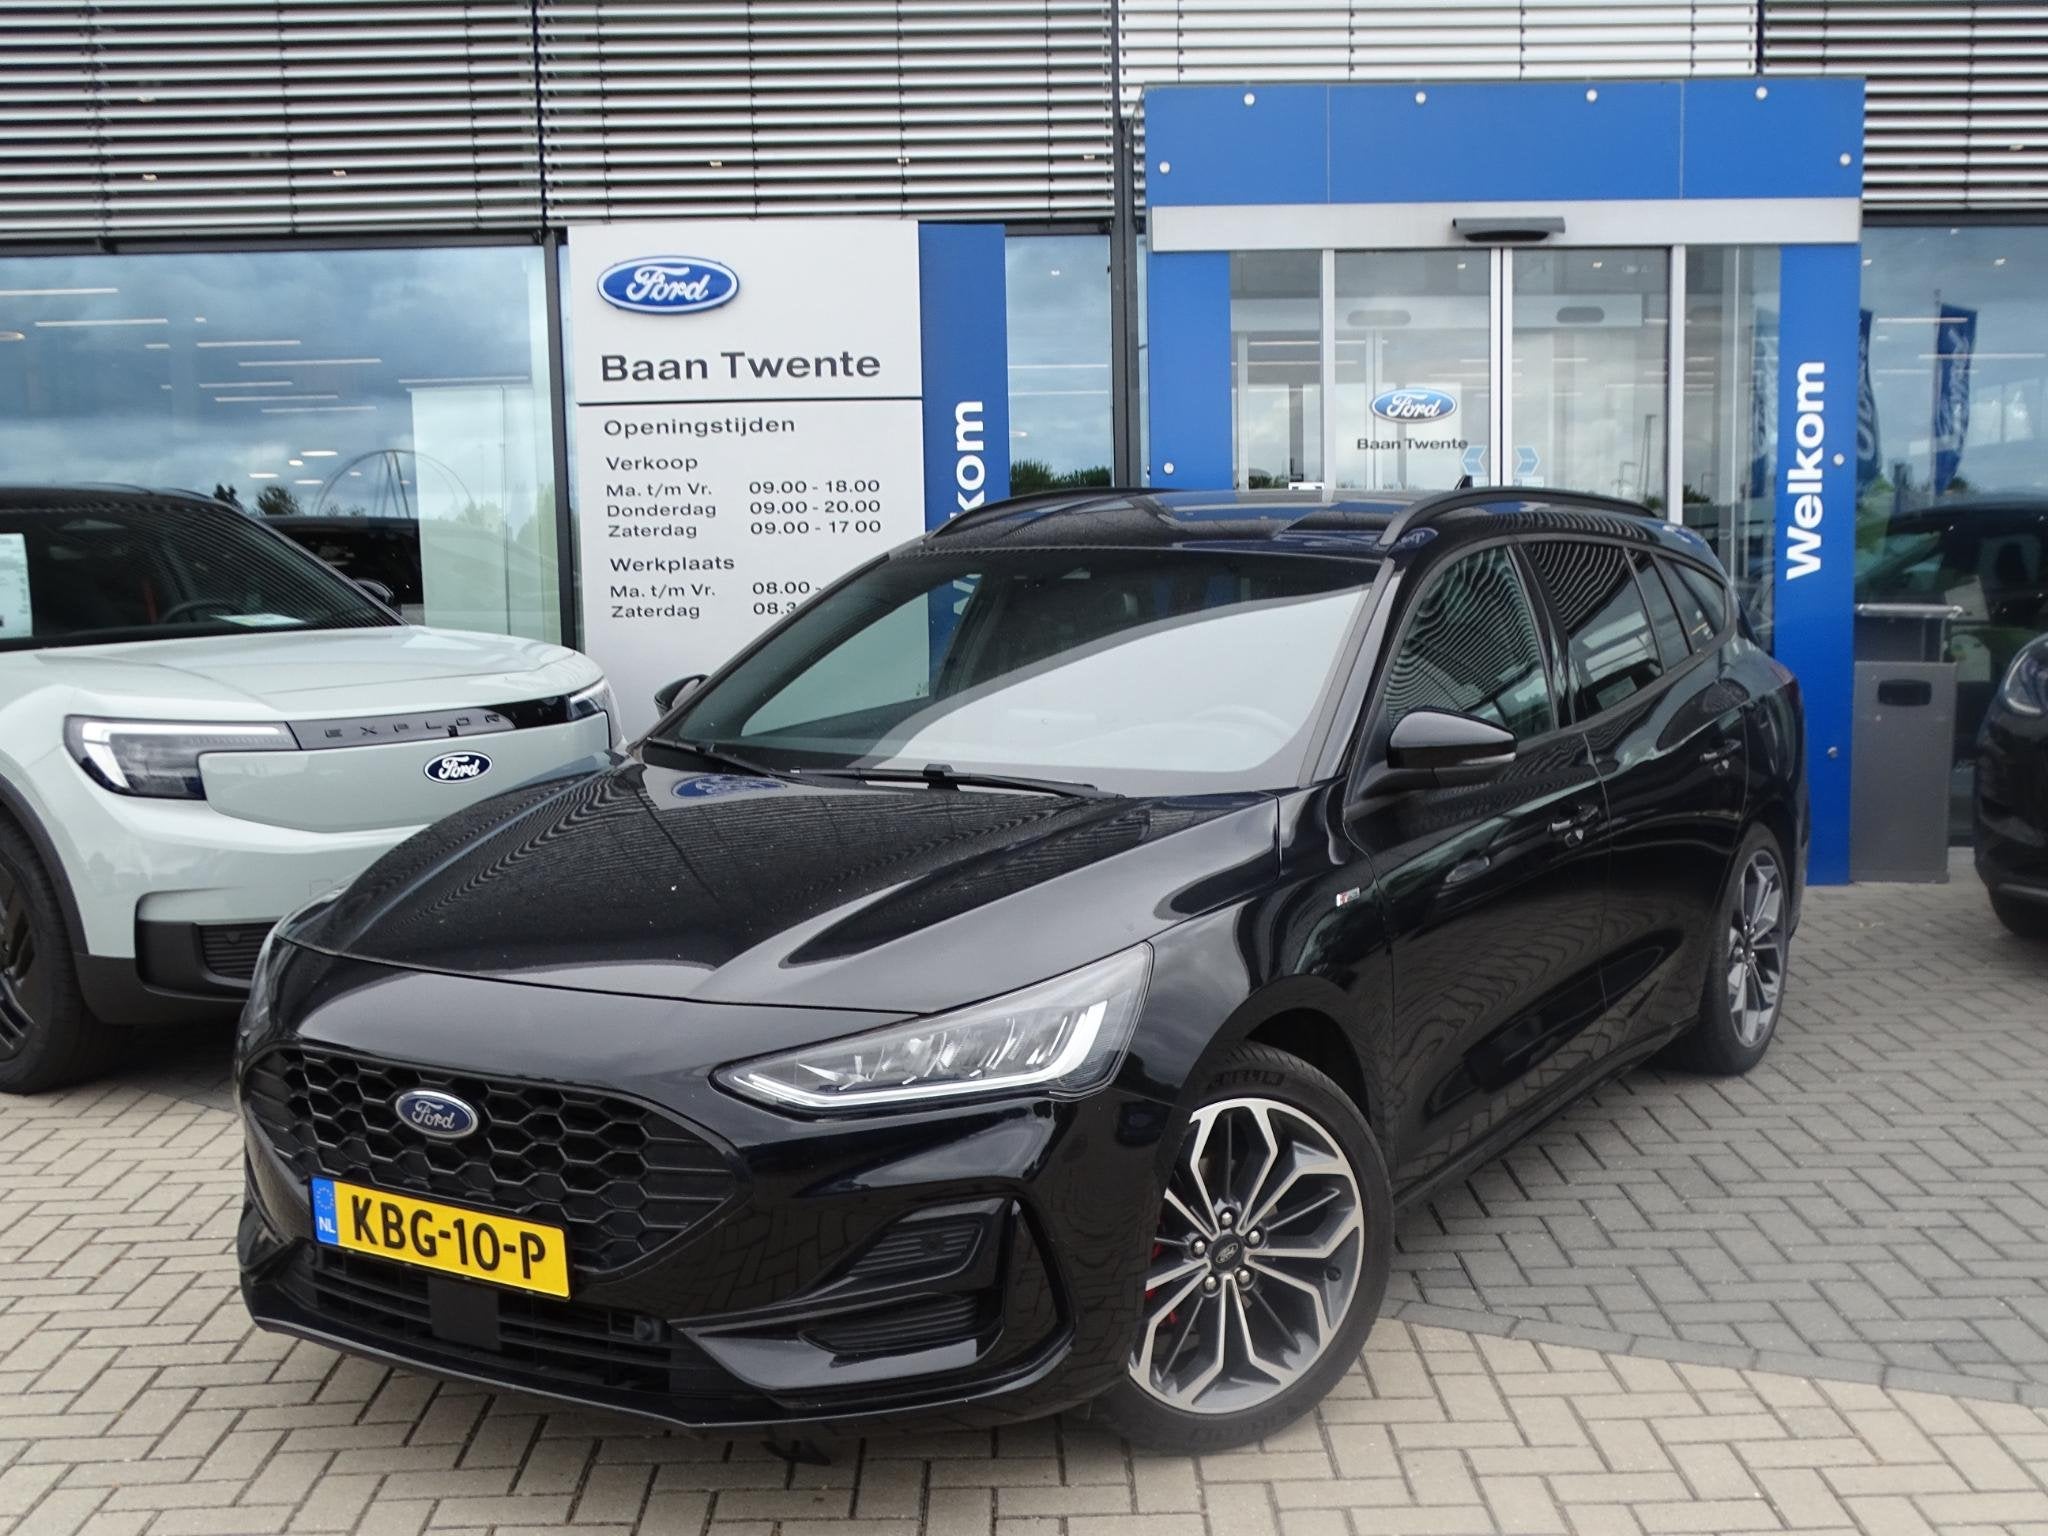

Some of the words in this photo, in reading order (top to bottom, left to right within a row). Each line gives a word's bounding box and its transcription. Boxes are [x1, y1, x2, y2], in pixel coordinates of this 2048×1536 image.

[626, 265, 709, 301] Ford
[601, 355, 708, 382] Baan
[720, 351, 881, 379] Twente
[1386, 390, 1441, 418] Ford
[604, 418, 795, 438] Openingstijden
[1357, 438, 1401, 450] Baan
[1404, 438, 1469, 450] Twente
[606, 456, 698, 473] Verkoop
[950, 400, 985, 519] kom
[1786, 362, 1825, 581] Welkom
[606, 484, 641, 497] Ma.
[647, 483, 681, 498] t/m
[687, 482, 712, 495] Vr.
[749, 481, 807, 494] 09.00
[826, 479, 880, 493] 18.00
[607, 503, 716, 518] Donderdag
[750, 501, 807, 514] 09.00
[825, 499, 880, 513] 20.00
[608, 523, 697, 539] Zaterdag
[751, 522, 809, 535] 09.00
[610, 556, 735, 574] Werkplaats
[610, 585, 645, 597] Ma.
[651, 584, 685, 599] t/m
[690, 583, 715, 596] Vr.
[753, 581, 810, 595] 08.00
[612, 604, 700, 619] Zaterdag
[753, 602, 798, 616] 08.3
[324, 706, 552, 738] EXPLOR
[438, 755, 480, 779] Ford
[319, 1216, 336, 1234] NL
[351, 1194, 546, 1280] KBG-10-P
